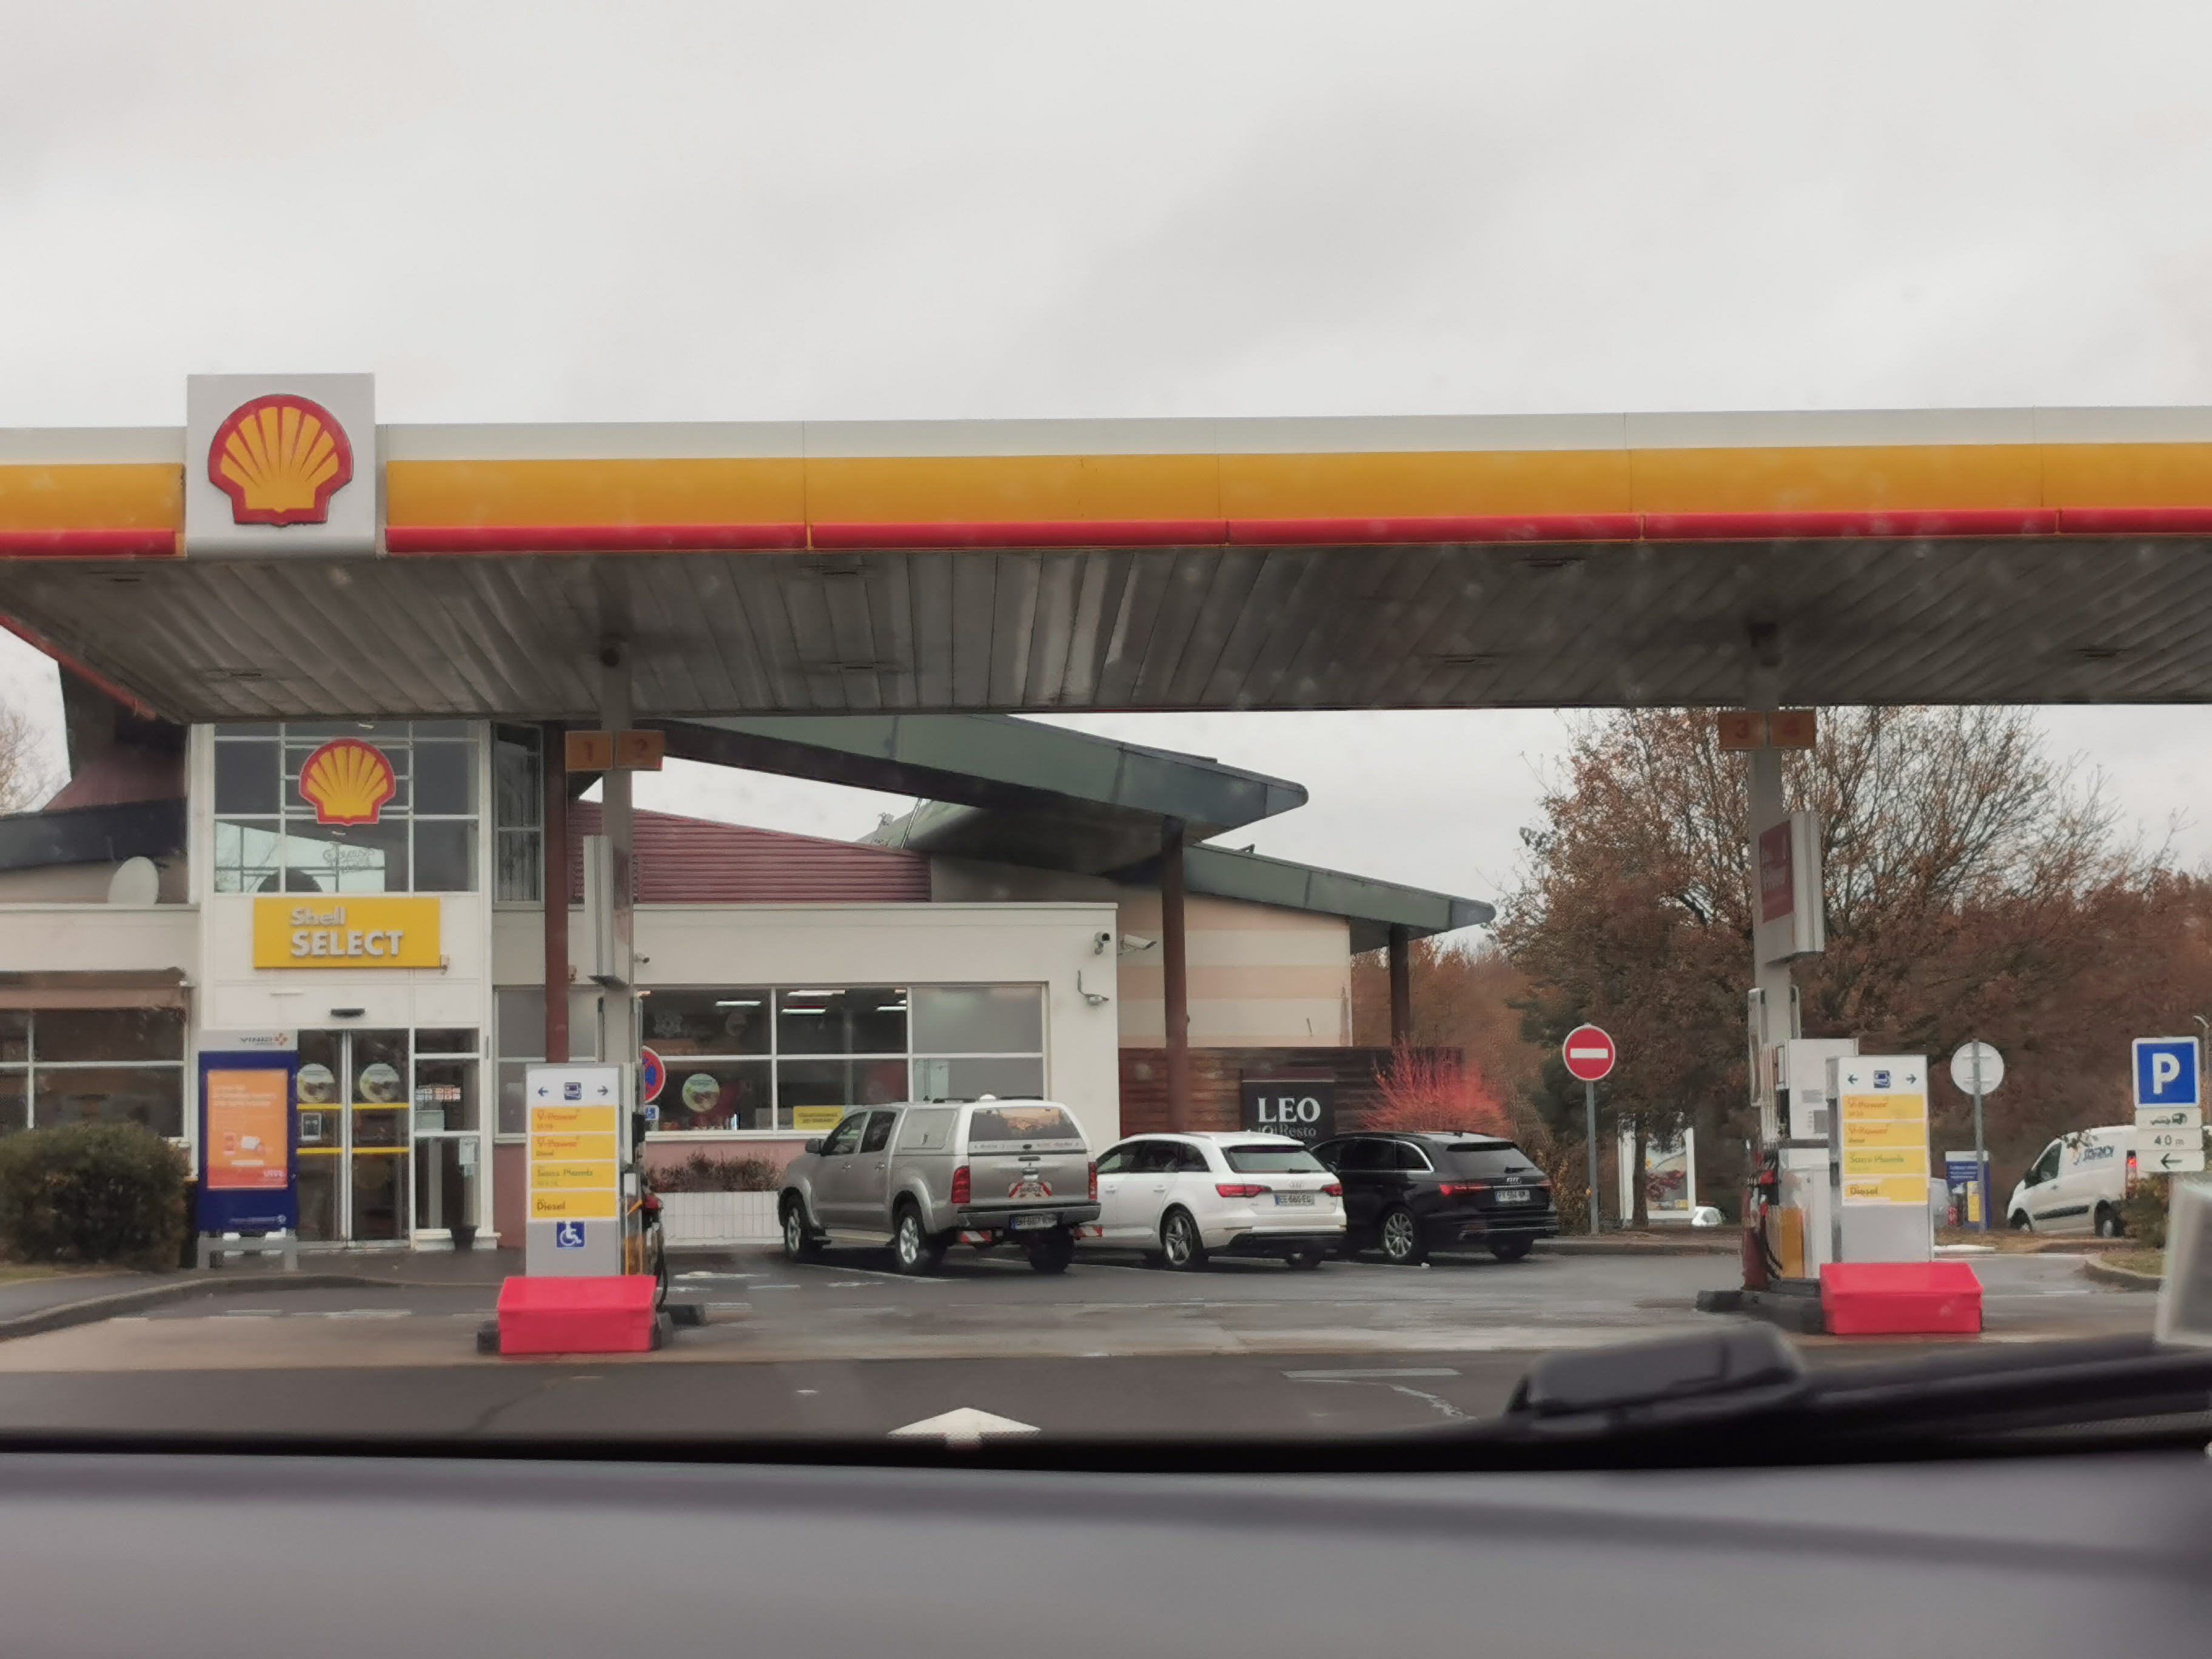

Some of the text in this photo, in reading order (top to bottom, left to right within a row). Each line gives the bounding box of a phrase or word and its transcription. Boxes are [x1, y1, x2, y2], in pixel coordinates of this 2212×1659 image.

[290, 907, 346, 925] Shell
[291, 930, 403, 956] SELECT
[2153, 1053, 2180, 1094] P
[1258, 1097, 1321, 1122] LEO
[1279, 1124, 1316, 1138] Resto
[2154, 1135, 2172, 1145] 40
[537, 1200, 566, 1211] Diesel
